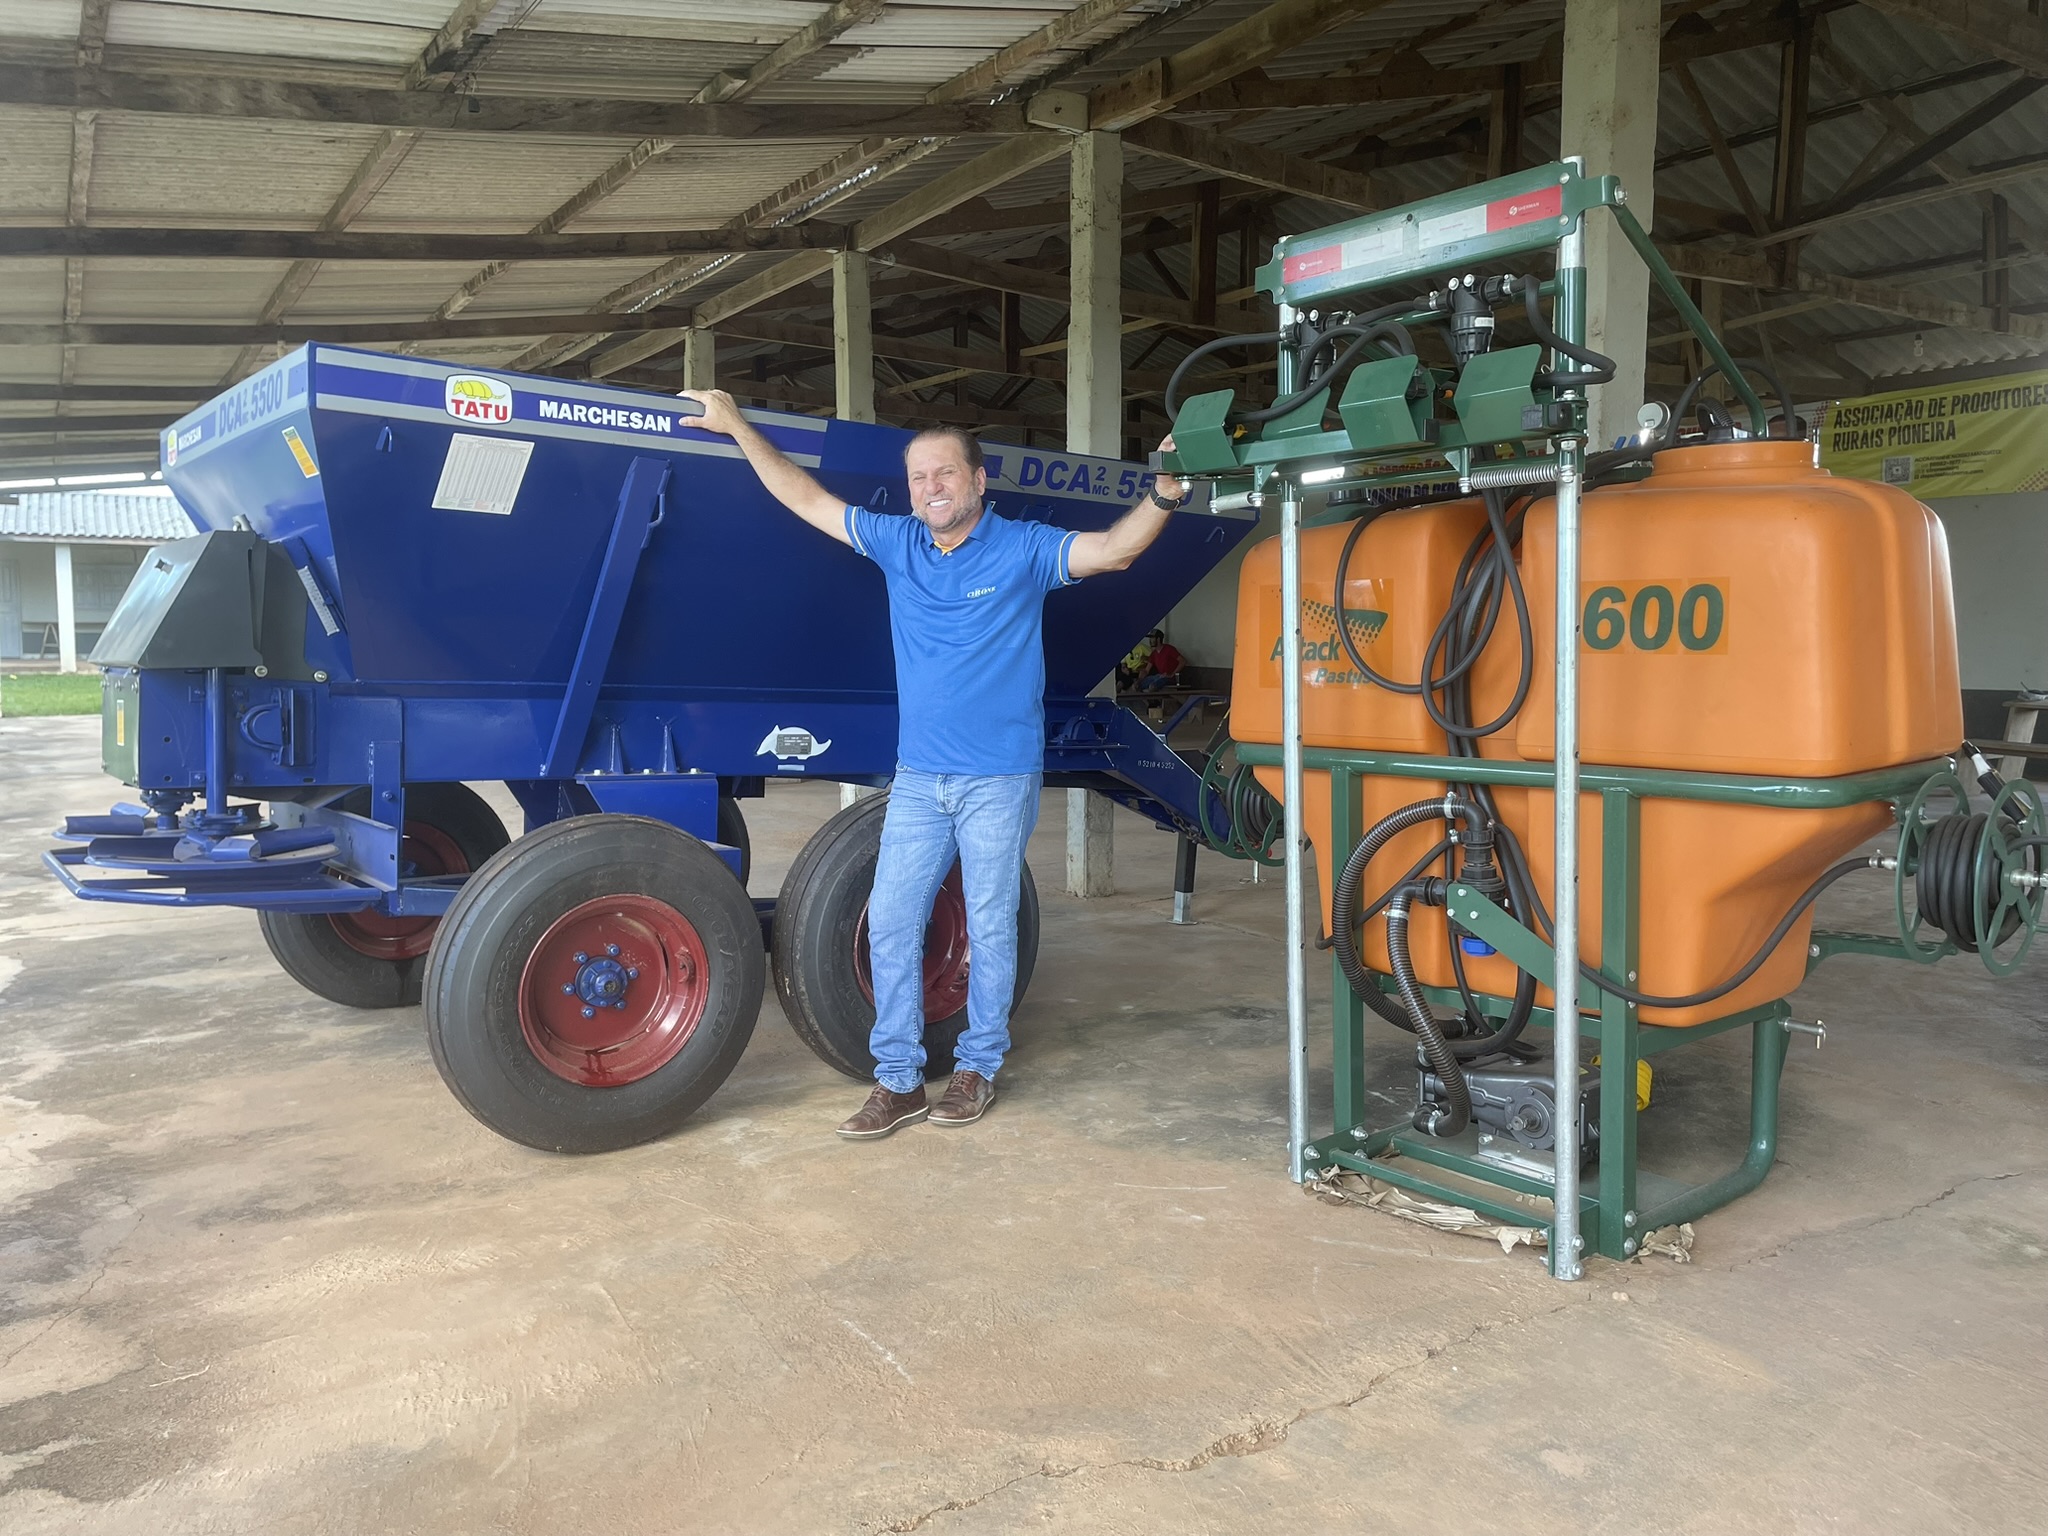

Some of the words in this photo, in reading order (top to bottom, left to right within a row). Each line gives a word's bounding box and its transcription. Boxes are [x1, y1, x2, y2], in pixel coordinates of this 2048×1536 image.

[219, 391, 241, 438] DCA
[251, 369, 283, 421] 5500
[451, 398, 509, 422] TATU
[538, 399, 672, 434] MARCHESAN
[1833, 399, 1924, 430] ASSOCIAÇÃO
[1928, 395, 1948, 418] DE
[1951, 384, 2048, 415] PRODUTORES
[1832, 428, 1884, 453] RURAIS
[1888, 419, 1957, 447] PIONEIRA
[1019, 456, 1091, 493] DCA
[1091, 484, 1110, 496] MC
[1583, 583, 1725, 652] 600
[1269, 633, 1342, 662] Atack
